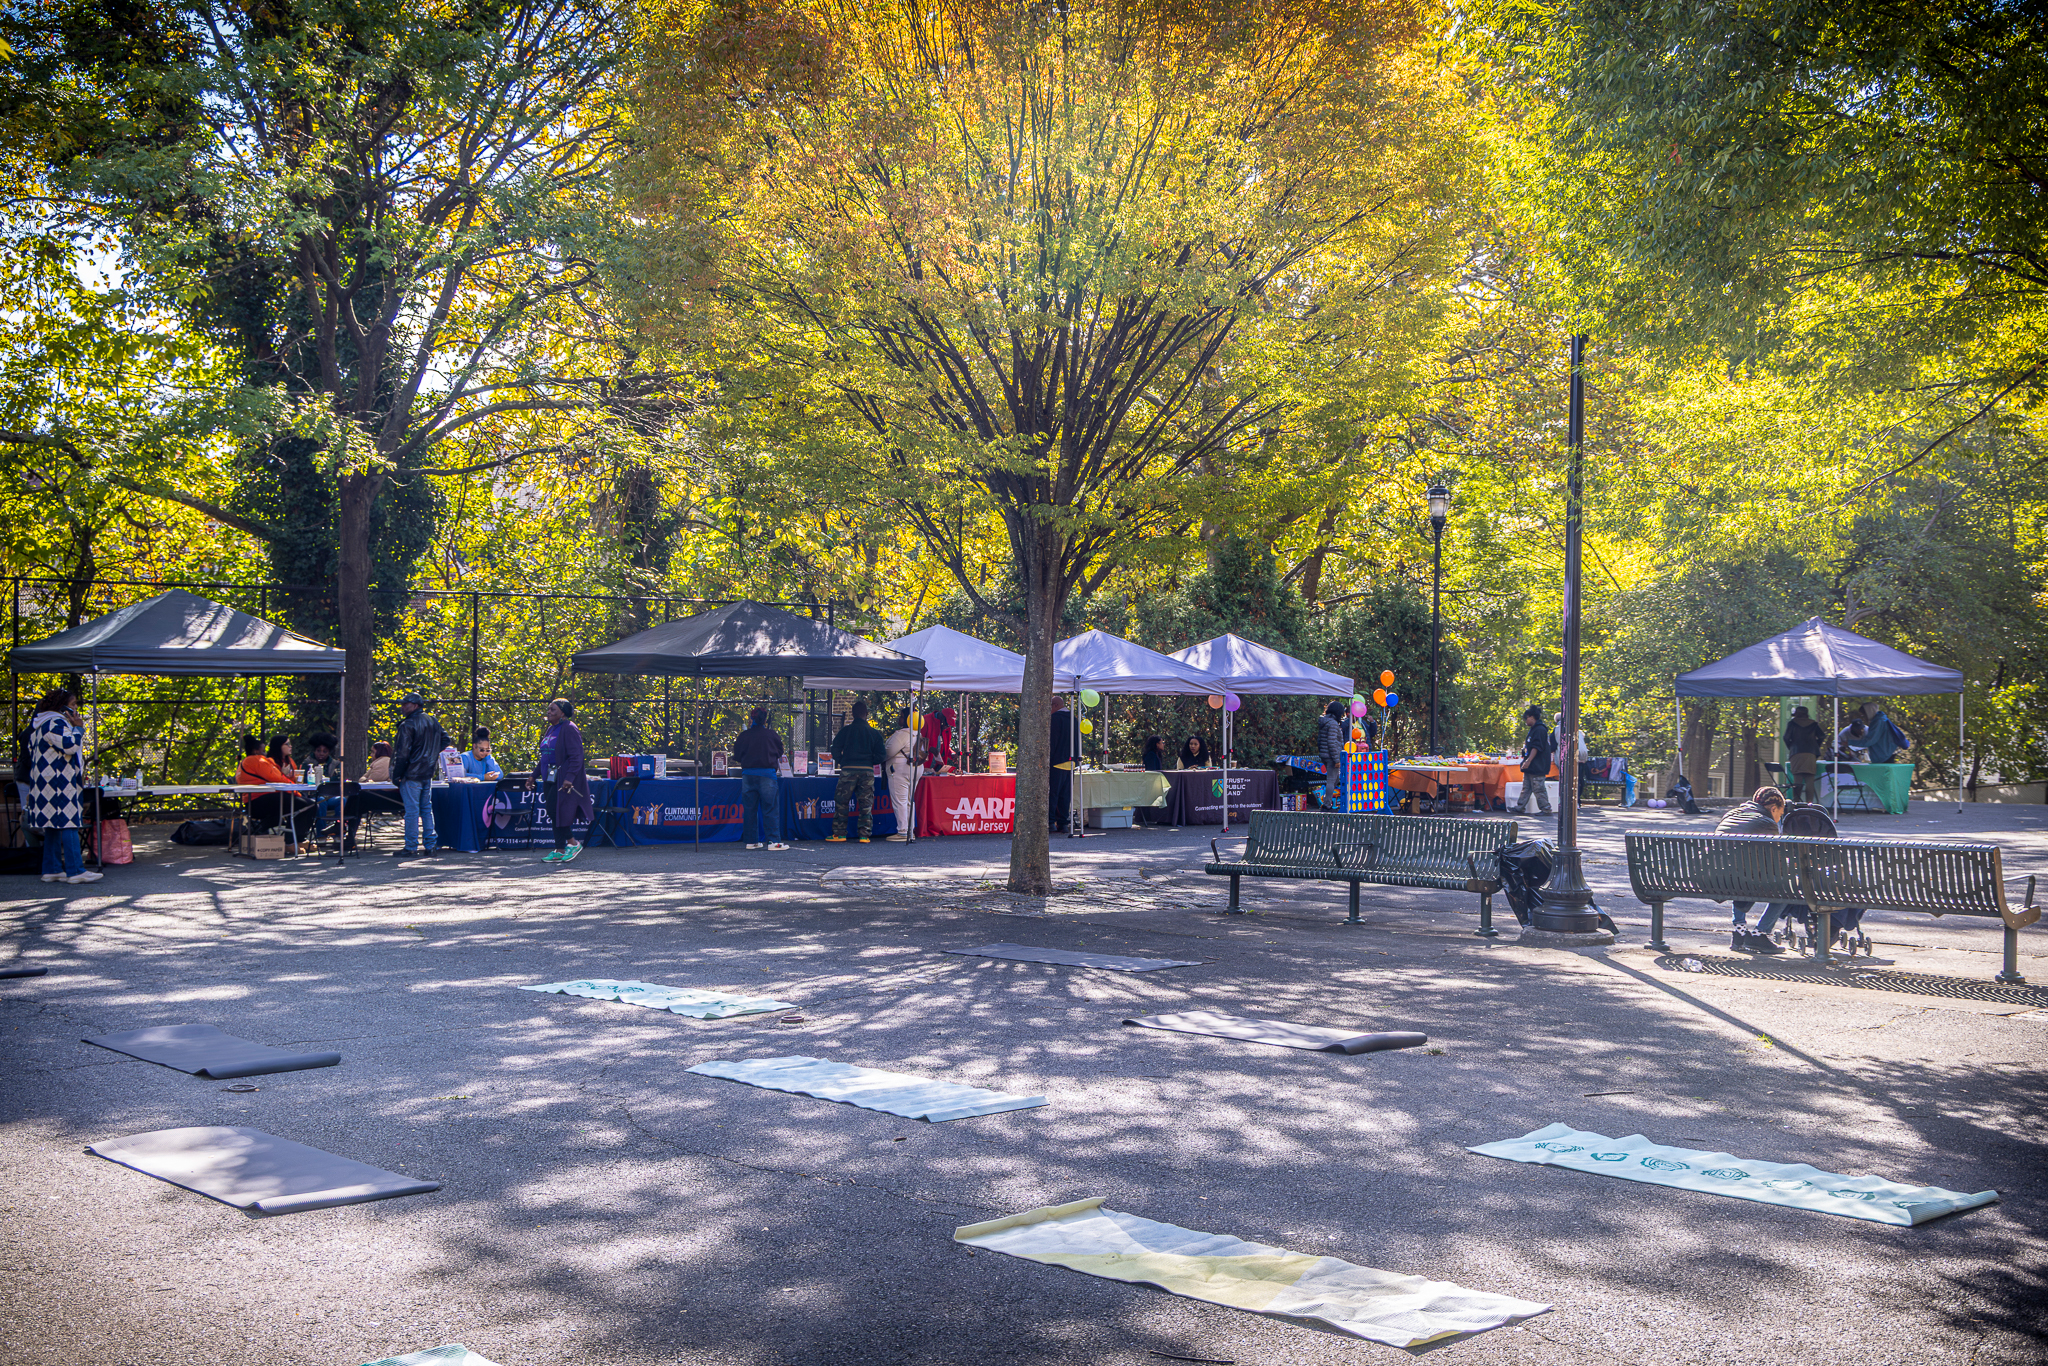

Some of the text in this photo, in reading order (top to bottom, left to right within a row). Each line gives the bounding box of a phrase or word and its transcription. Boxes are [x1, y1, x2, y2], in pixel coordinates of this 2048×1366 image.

[664, 807, 702, 815] CLINTON HIL
[945, 797, 1016, 819] AARP
[952, 820, 1010, 834] New Jersey
